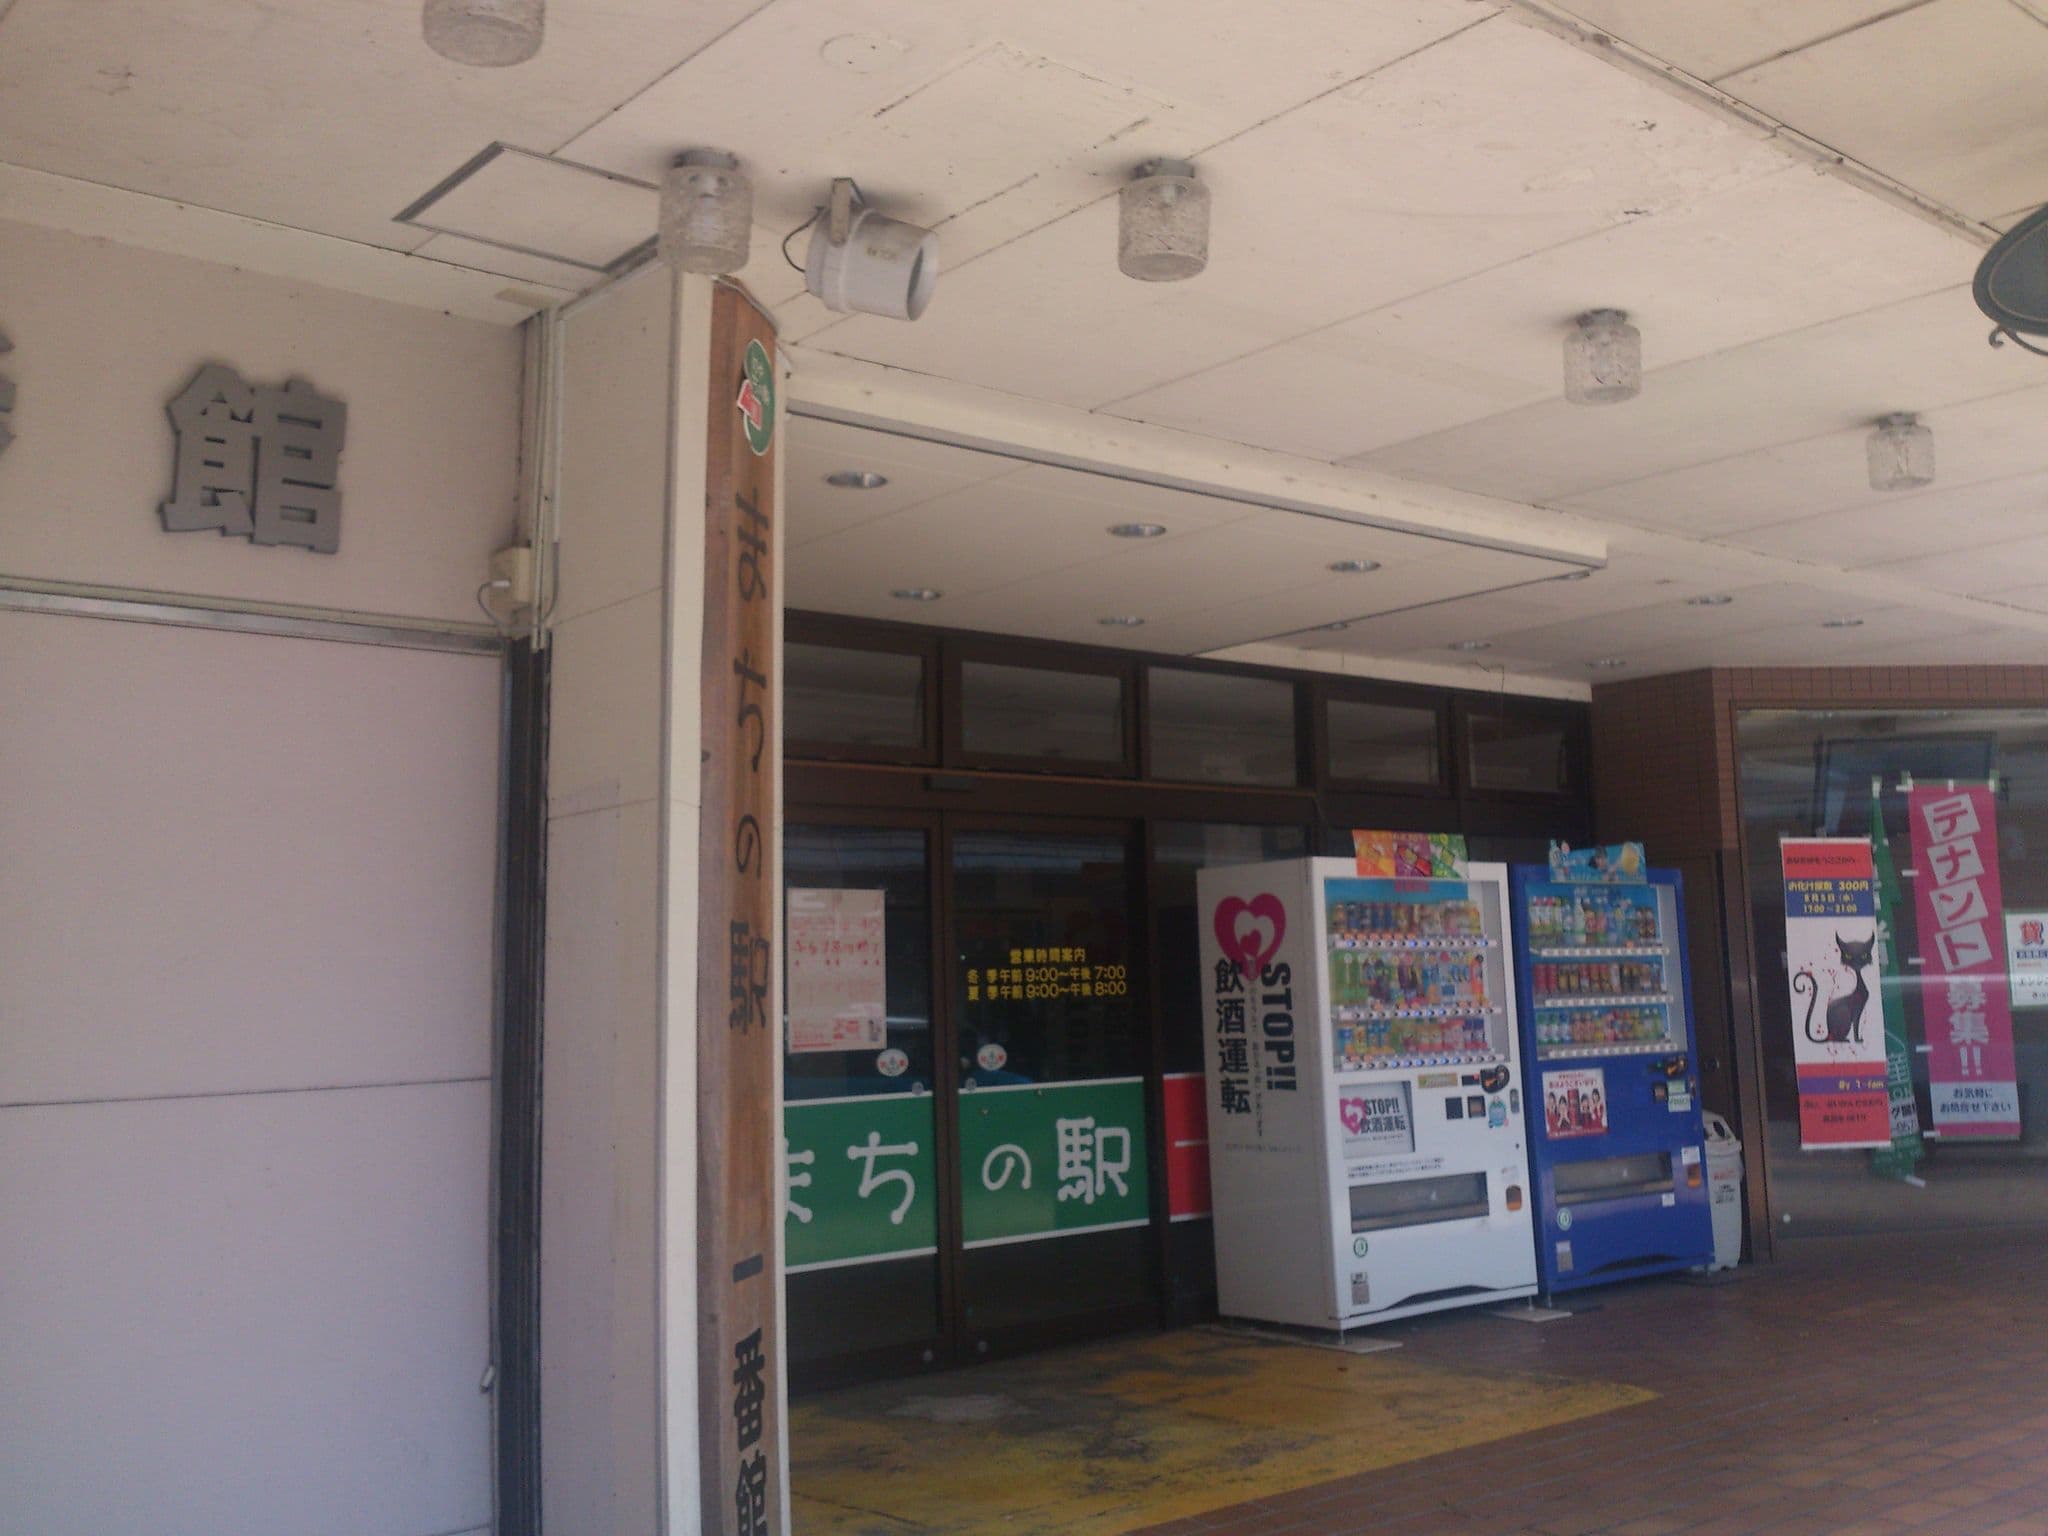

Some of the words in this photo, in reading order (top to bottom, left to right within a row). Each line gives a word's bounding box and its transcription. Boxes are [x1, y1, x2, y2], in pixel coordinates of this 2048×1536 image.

[1214, 958, 1252, 1115] 飲酒運転
[1260, 961, 1298, 1092] STOP!!
[1365, 1097, 1401, 1116] STOP!!
